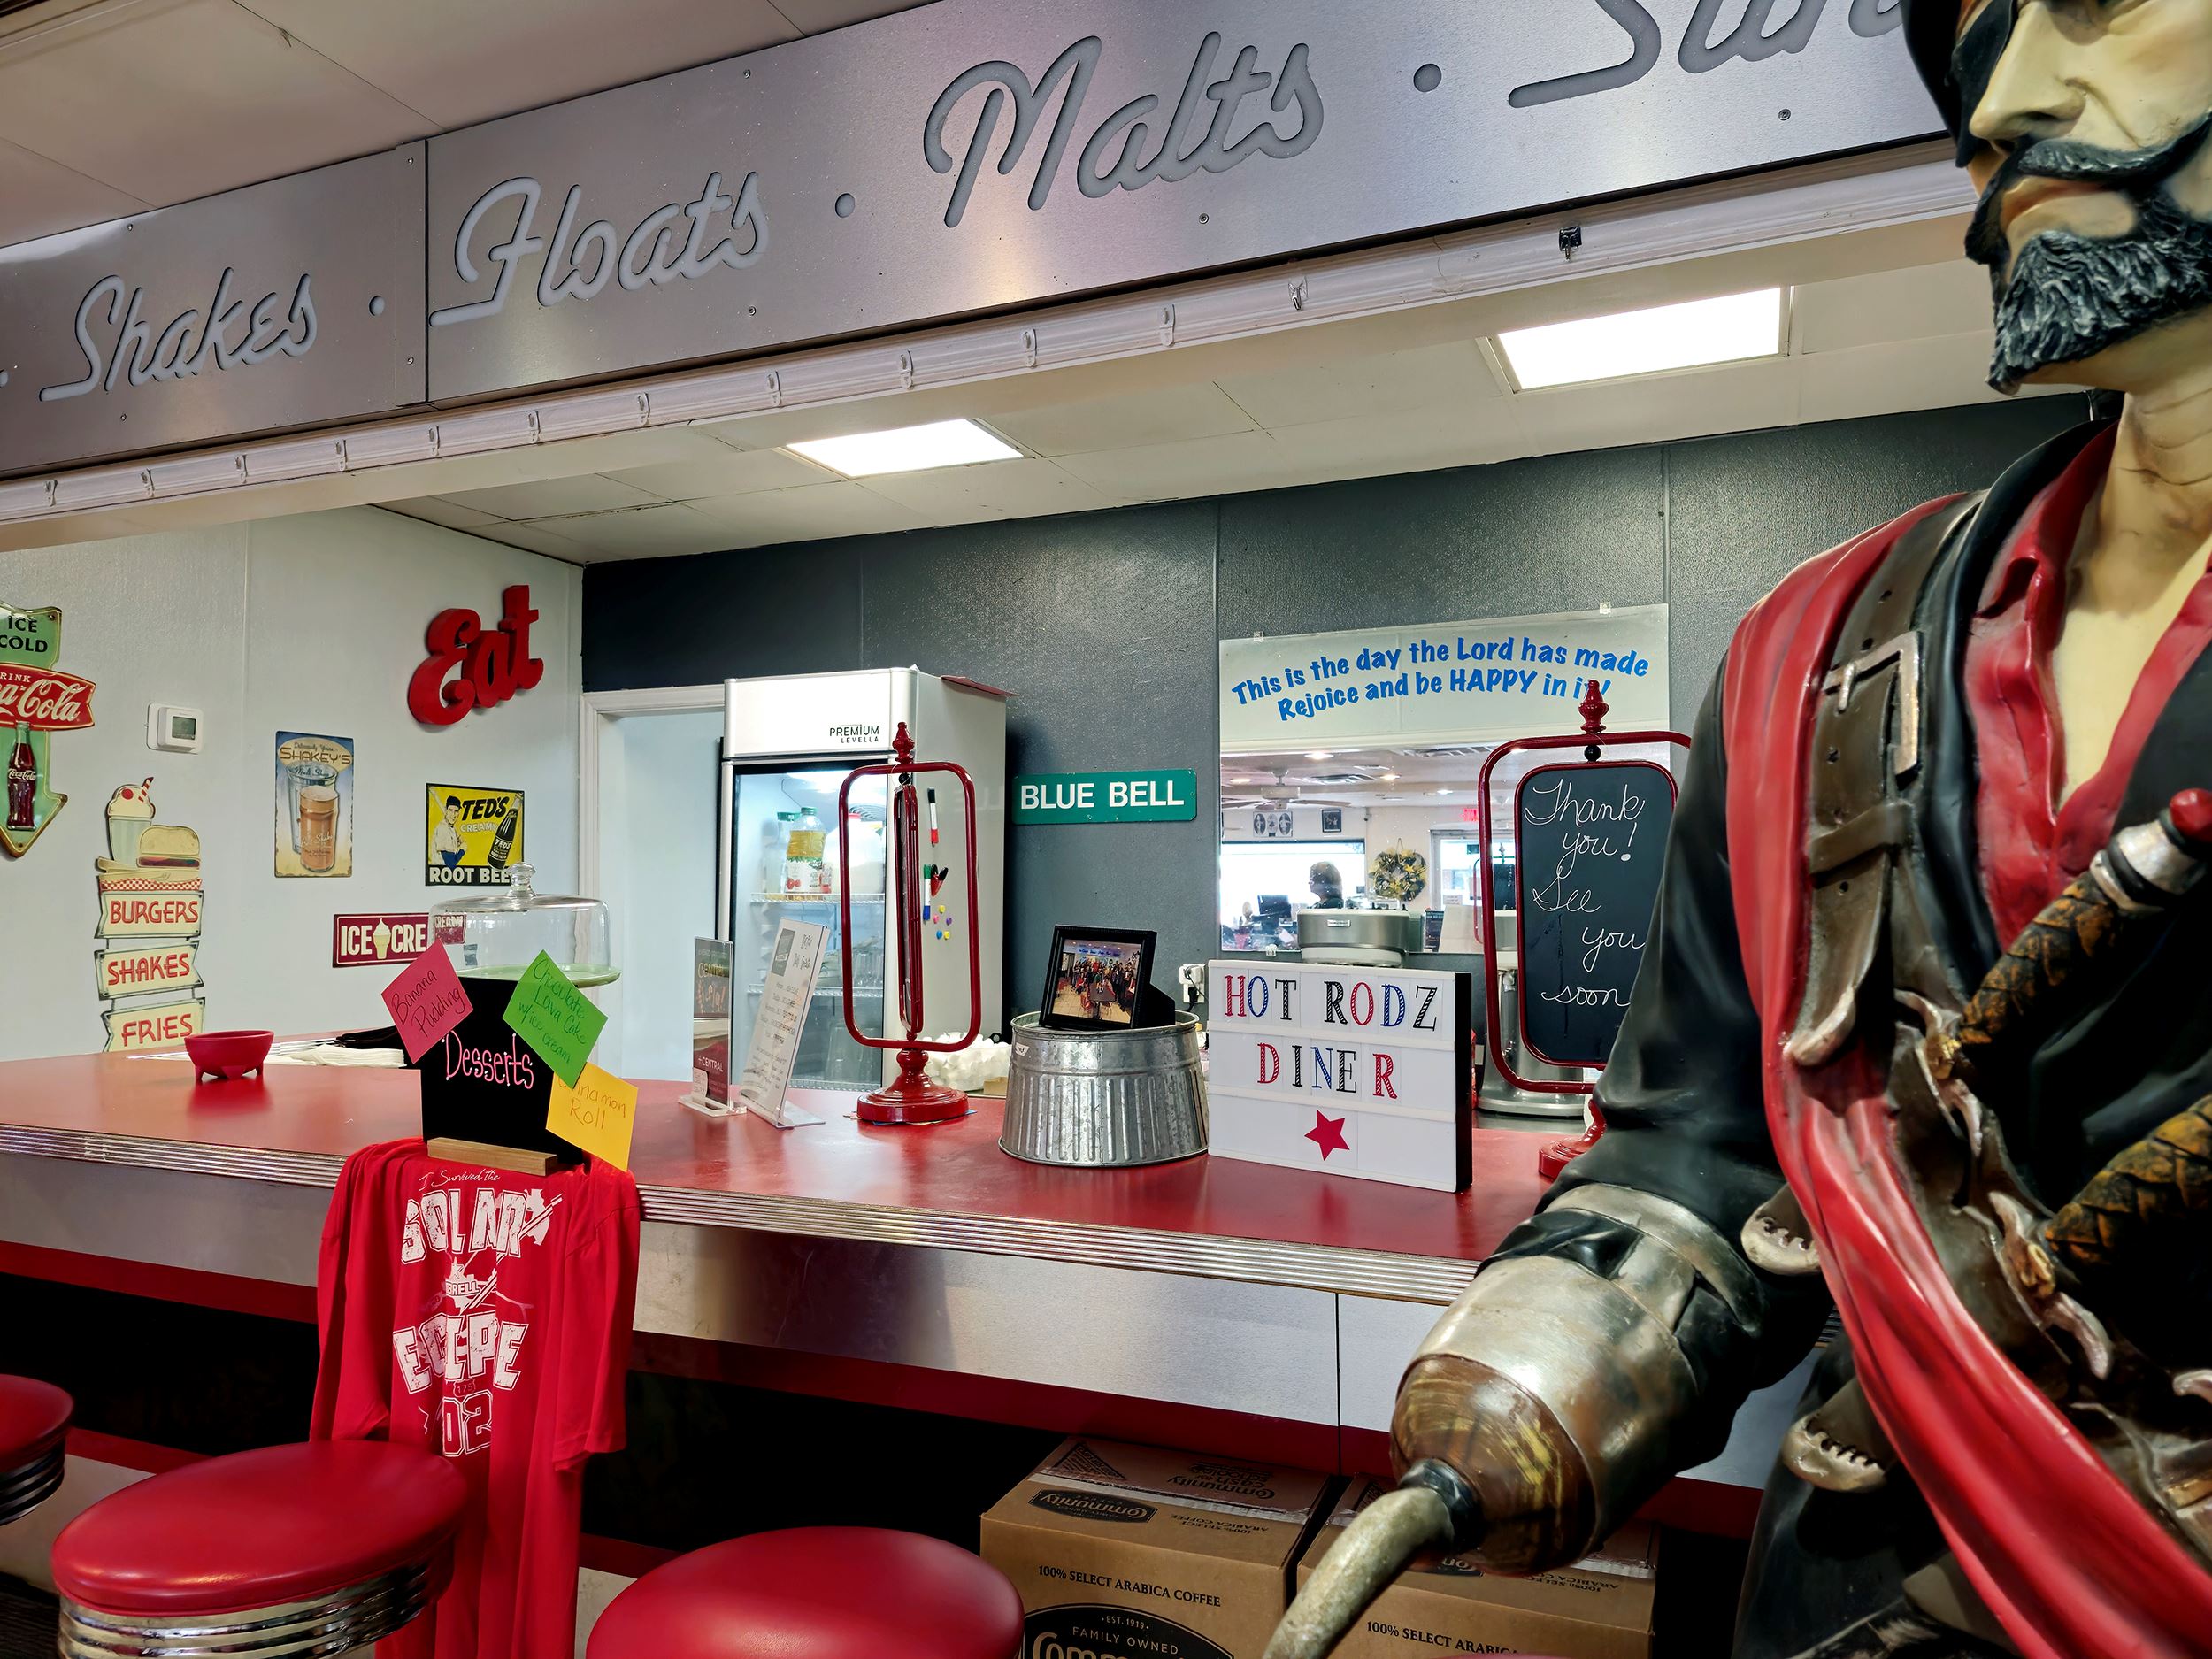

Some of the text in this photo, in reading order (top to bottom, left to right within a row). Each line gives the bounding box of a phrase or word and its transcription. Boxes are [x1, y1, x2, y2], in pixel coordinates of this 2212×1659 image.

[39, 266, 319, 402] Shakes
[429, 171, 772, 326] Floats
[922, 30, 1324, 228] Malts
[8, 616, 37, 633] ICE
[0, 635, 48, 652] COLD
[408, 585, 543, 726] Eat
[0, 672, 31, 682] RINK
[1232, 636, 1649, 704] This is the day the Lord has made
[1278, 668, 1612, 721] Rejoice and be HAPPY in i!
[829, 724, 879, 736] PREMIUM
[280, 747, 350, 764] SHAKEY'S
[462, 796, 510, 821] TED'S
[1021, 780, 1185, 810] BLUE BELL
[1524, 779, 1645, 827] Thank
[1556, 822, 1637, 879] you!
[429, 867, 512, 883] ROOT BEE
[1532, 865, 1601, 913] See
[110, 898, 199, 925] BURGERS
[341, 923, 426, 956] ICE CRE
[1581, 927, 1646, 972] you
[107, 952, 191, 986] SHAKES
[391, 969, 438, 1025] Banana
[411, 986, 465, 1038] Pudding
[1224, 975, 1438, 1032] HOT RODZ
[1541, 986, 1631, 1006] soon
[121, 1013, 193, 1048] FRIES
[563, 1014, 587, 1044] Cake
[442, 1030, 534, 1089] Desserts
[1257, 1042, 1398, 1099] DINER
[570, 1097, 605, 1129] Roll
[419, 1169, 500, 1191] I Survived the
[1167, 1476, 1275, 1499] Community
[1041, 1494, 1148, 1518] Community
[1039, 1564, 1221, 1607] 100% SELECT ARABICA COFFEE
[1106, 1615, 1145, 1629] EST. 1919
[1367, 1621, 1517, 1654] 100% SELECT ARABI
[1072, 1626, 1120, 1644] FAMILY
[1126, 1637, 1179, 1655] OWNED
